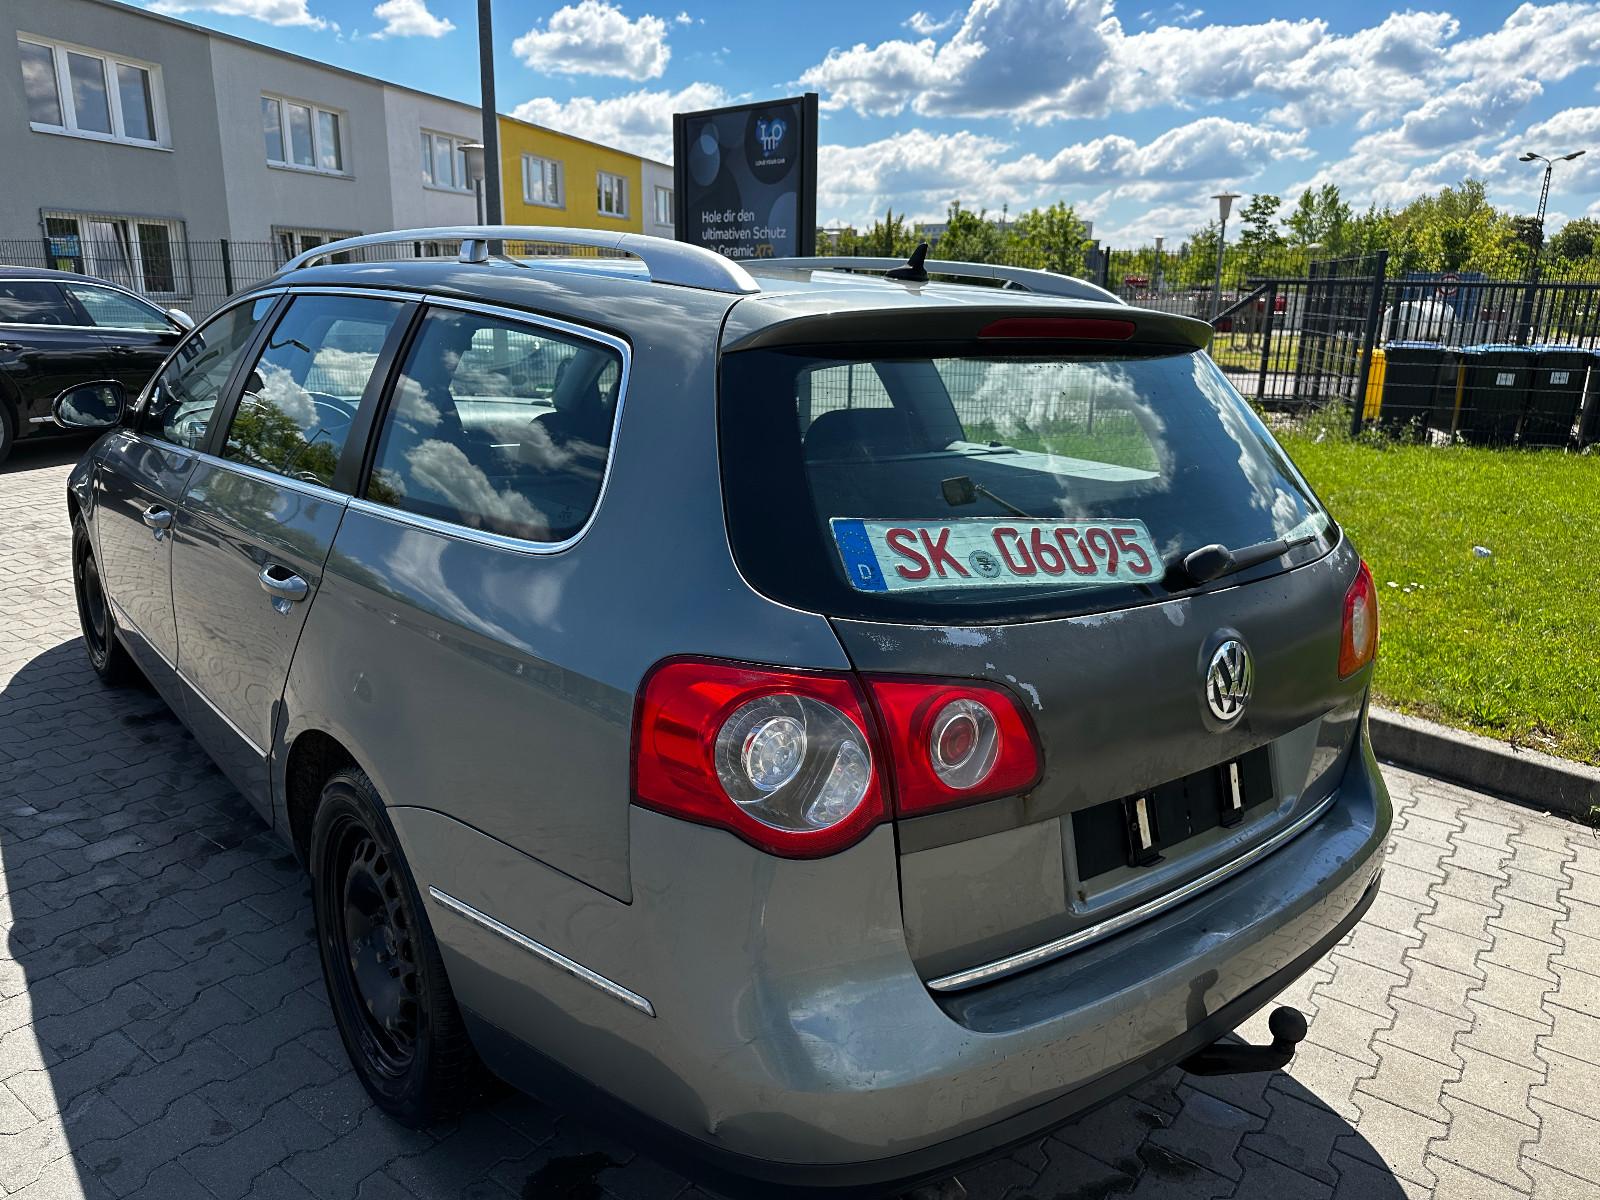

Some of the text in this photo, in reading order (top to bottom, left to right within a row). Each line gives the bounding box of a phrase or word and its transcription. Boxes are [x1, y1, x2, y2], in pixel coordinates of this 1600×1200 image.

[702, 208, 755, 223] Hole dir den
[702, 225, 787, 240] ultimativen Schutz
[718, 244, 754, 257] Ceramic
[885, 527, 971, 581] SK
[991, 527, 1152, 577] 06095
[857, 563, 872, 580] D
